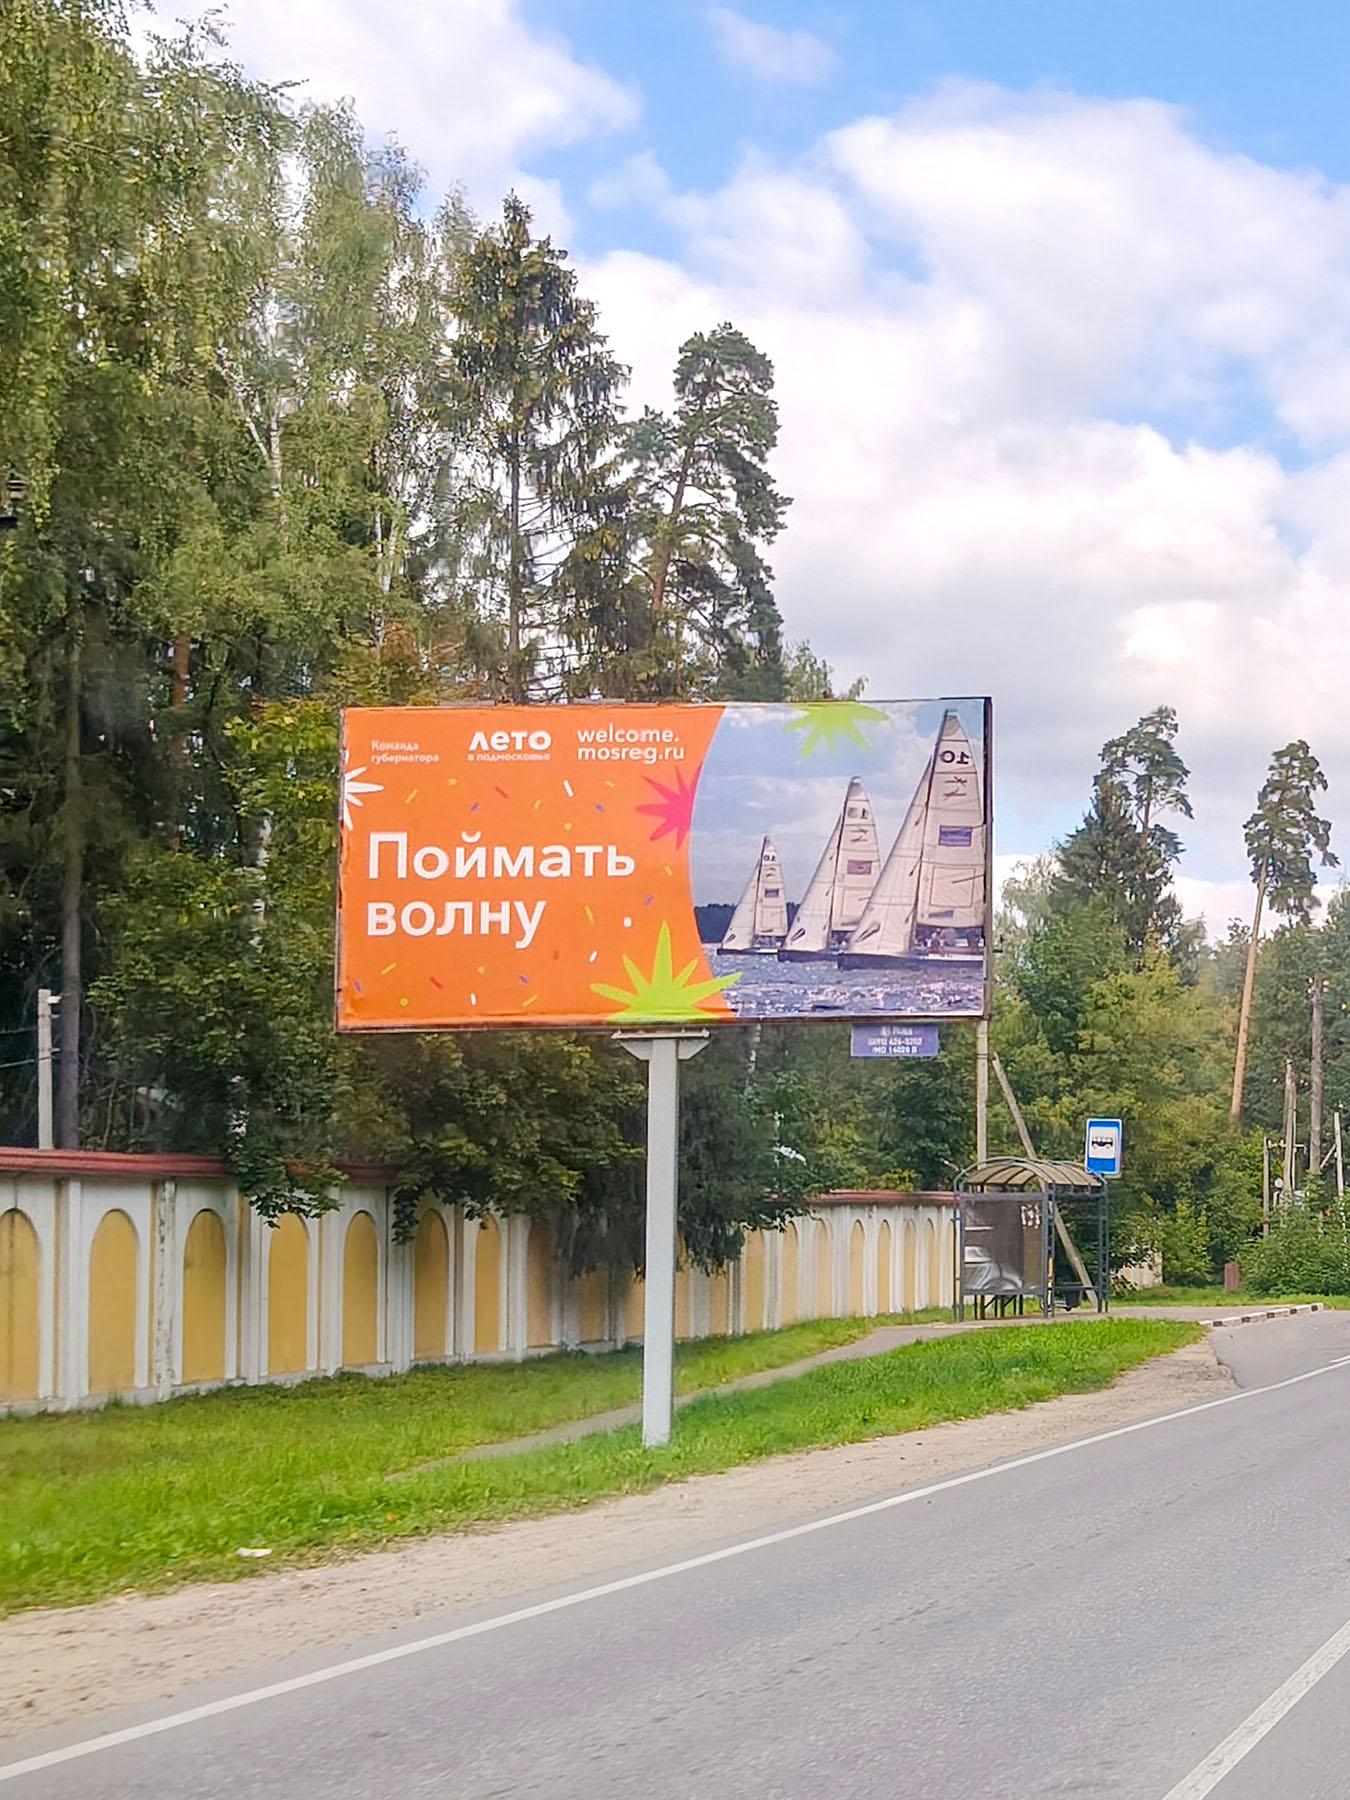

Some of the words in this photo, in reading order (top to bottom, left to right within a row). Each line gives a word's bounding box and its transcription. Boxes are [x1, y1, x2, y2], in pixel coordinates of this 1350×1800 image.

[577, 723, 680, 743] welcome.
[371, 740, 419, 752] Команда
[577, 746, 685, 765] mosreg.ru
[371, 753, 440, 765] губернатора
[476, 753, 551, 763] подмосковье
[368, 831, 636, 880] Поймать
[367, 900, 547, 949] волну
